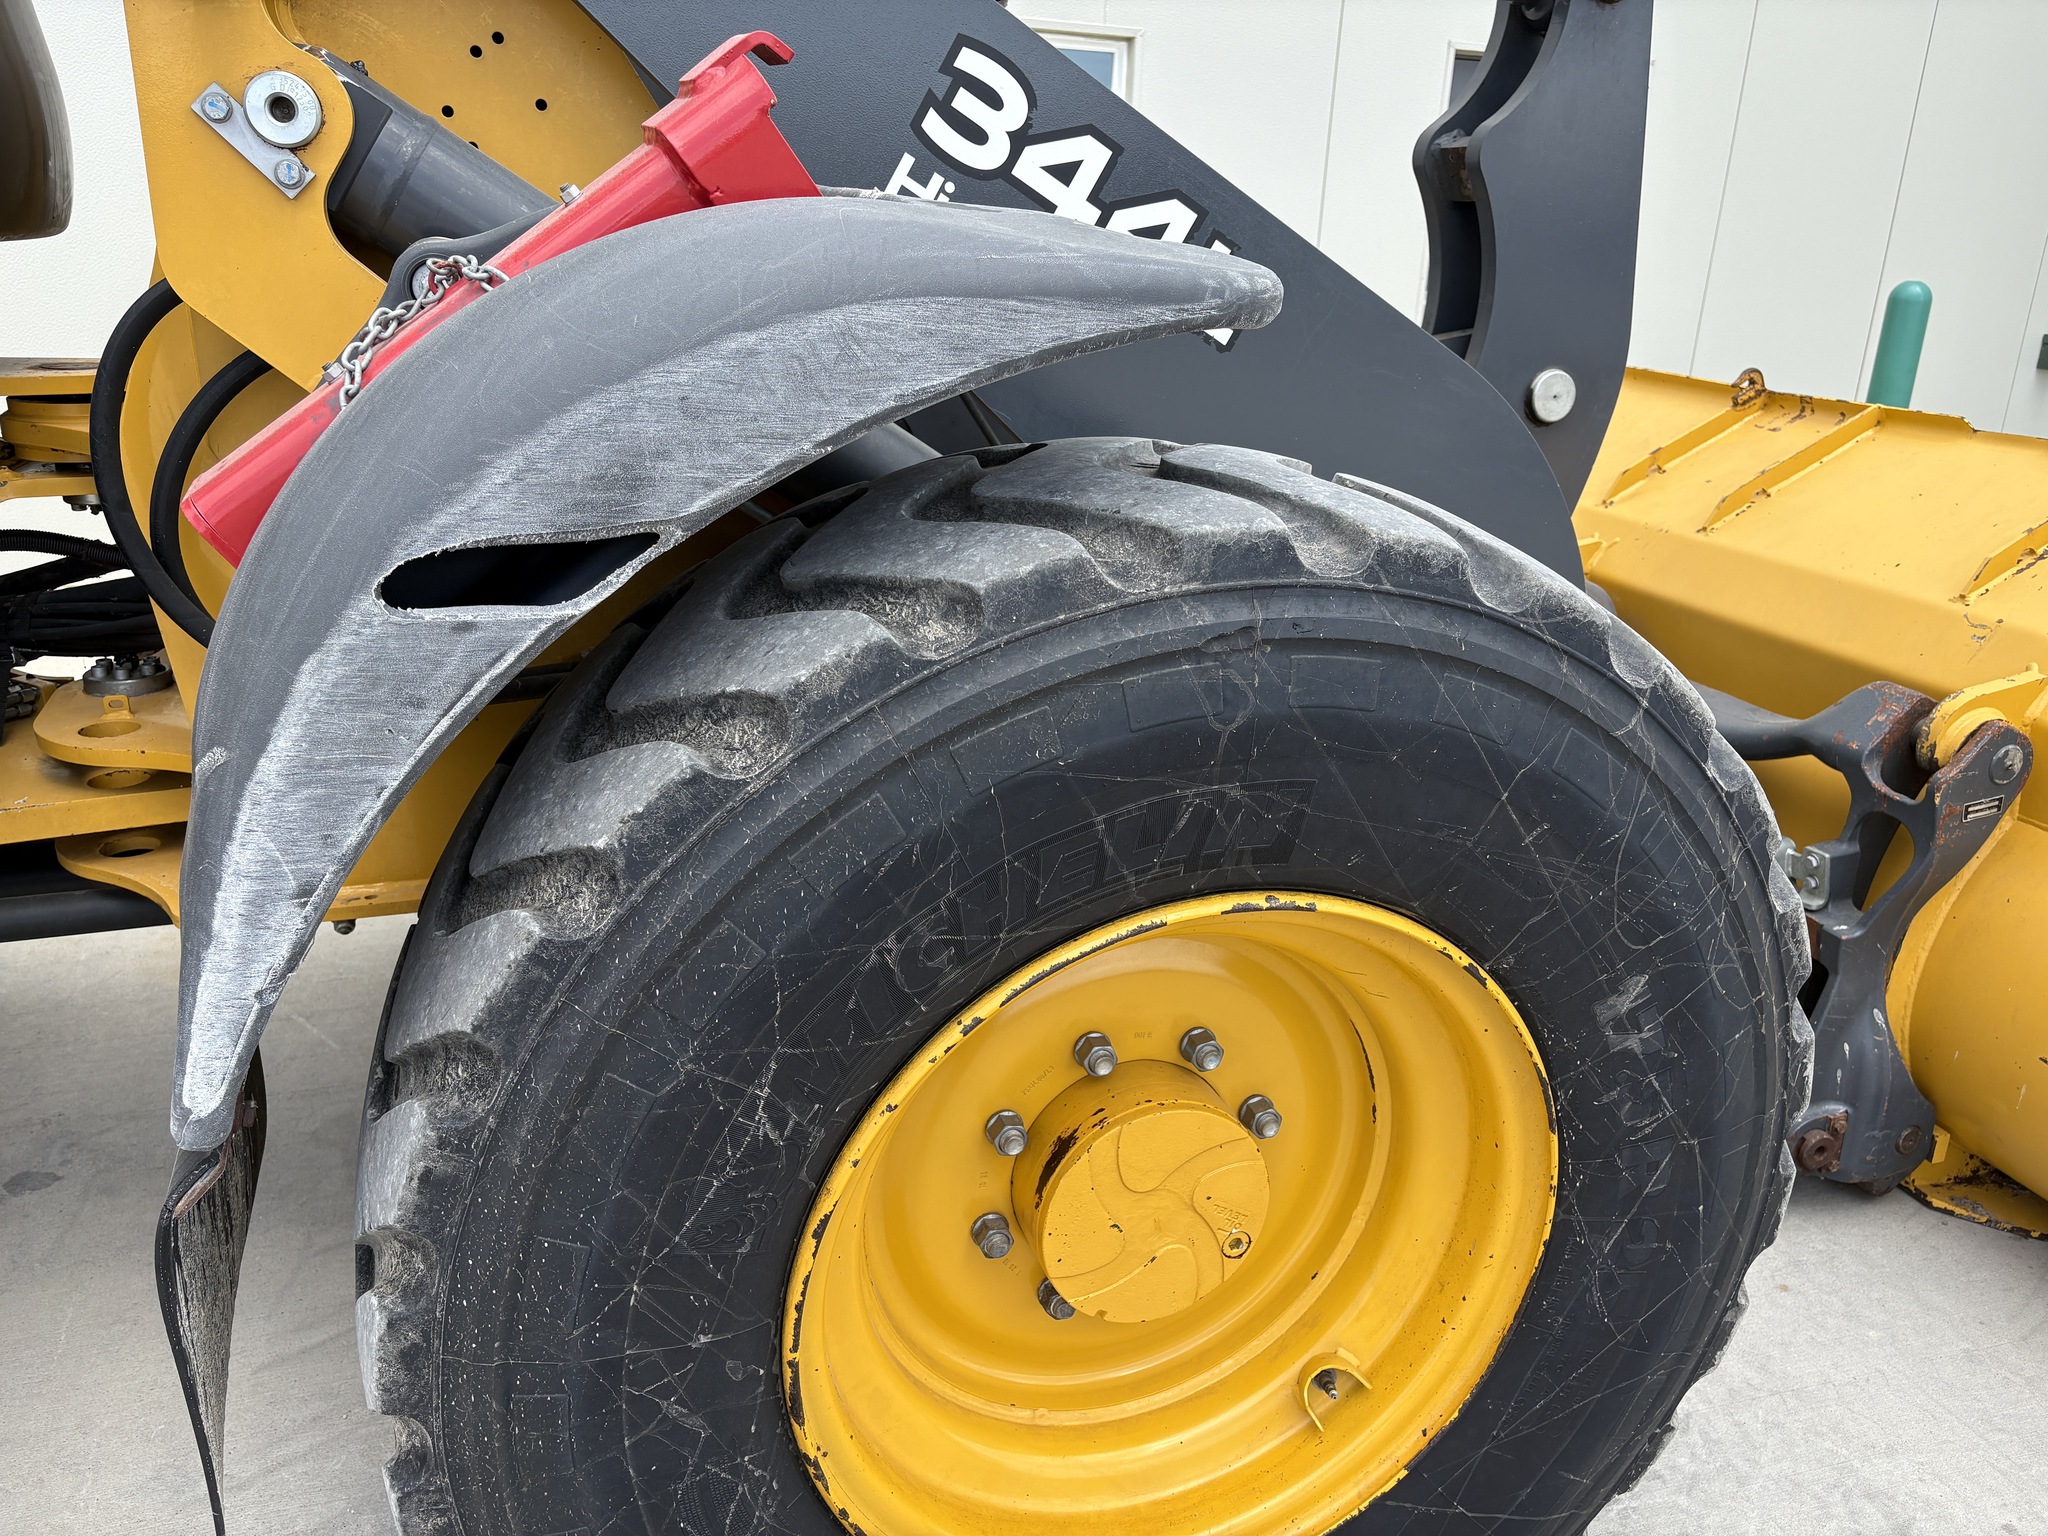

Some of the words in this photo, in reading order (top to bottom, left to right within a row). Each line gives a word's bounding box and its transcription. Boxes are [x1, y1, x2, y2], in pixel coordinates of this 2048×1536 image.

[767, 784, 1308, 1124] MICHELIN
[1212, 1203, 1249, 1225] LEVEL
[1223, 1218, 1242, 1230] OIL
